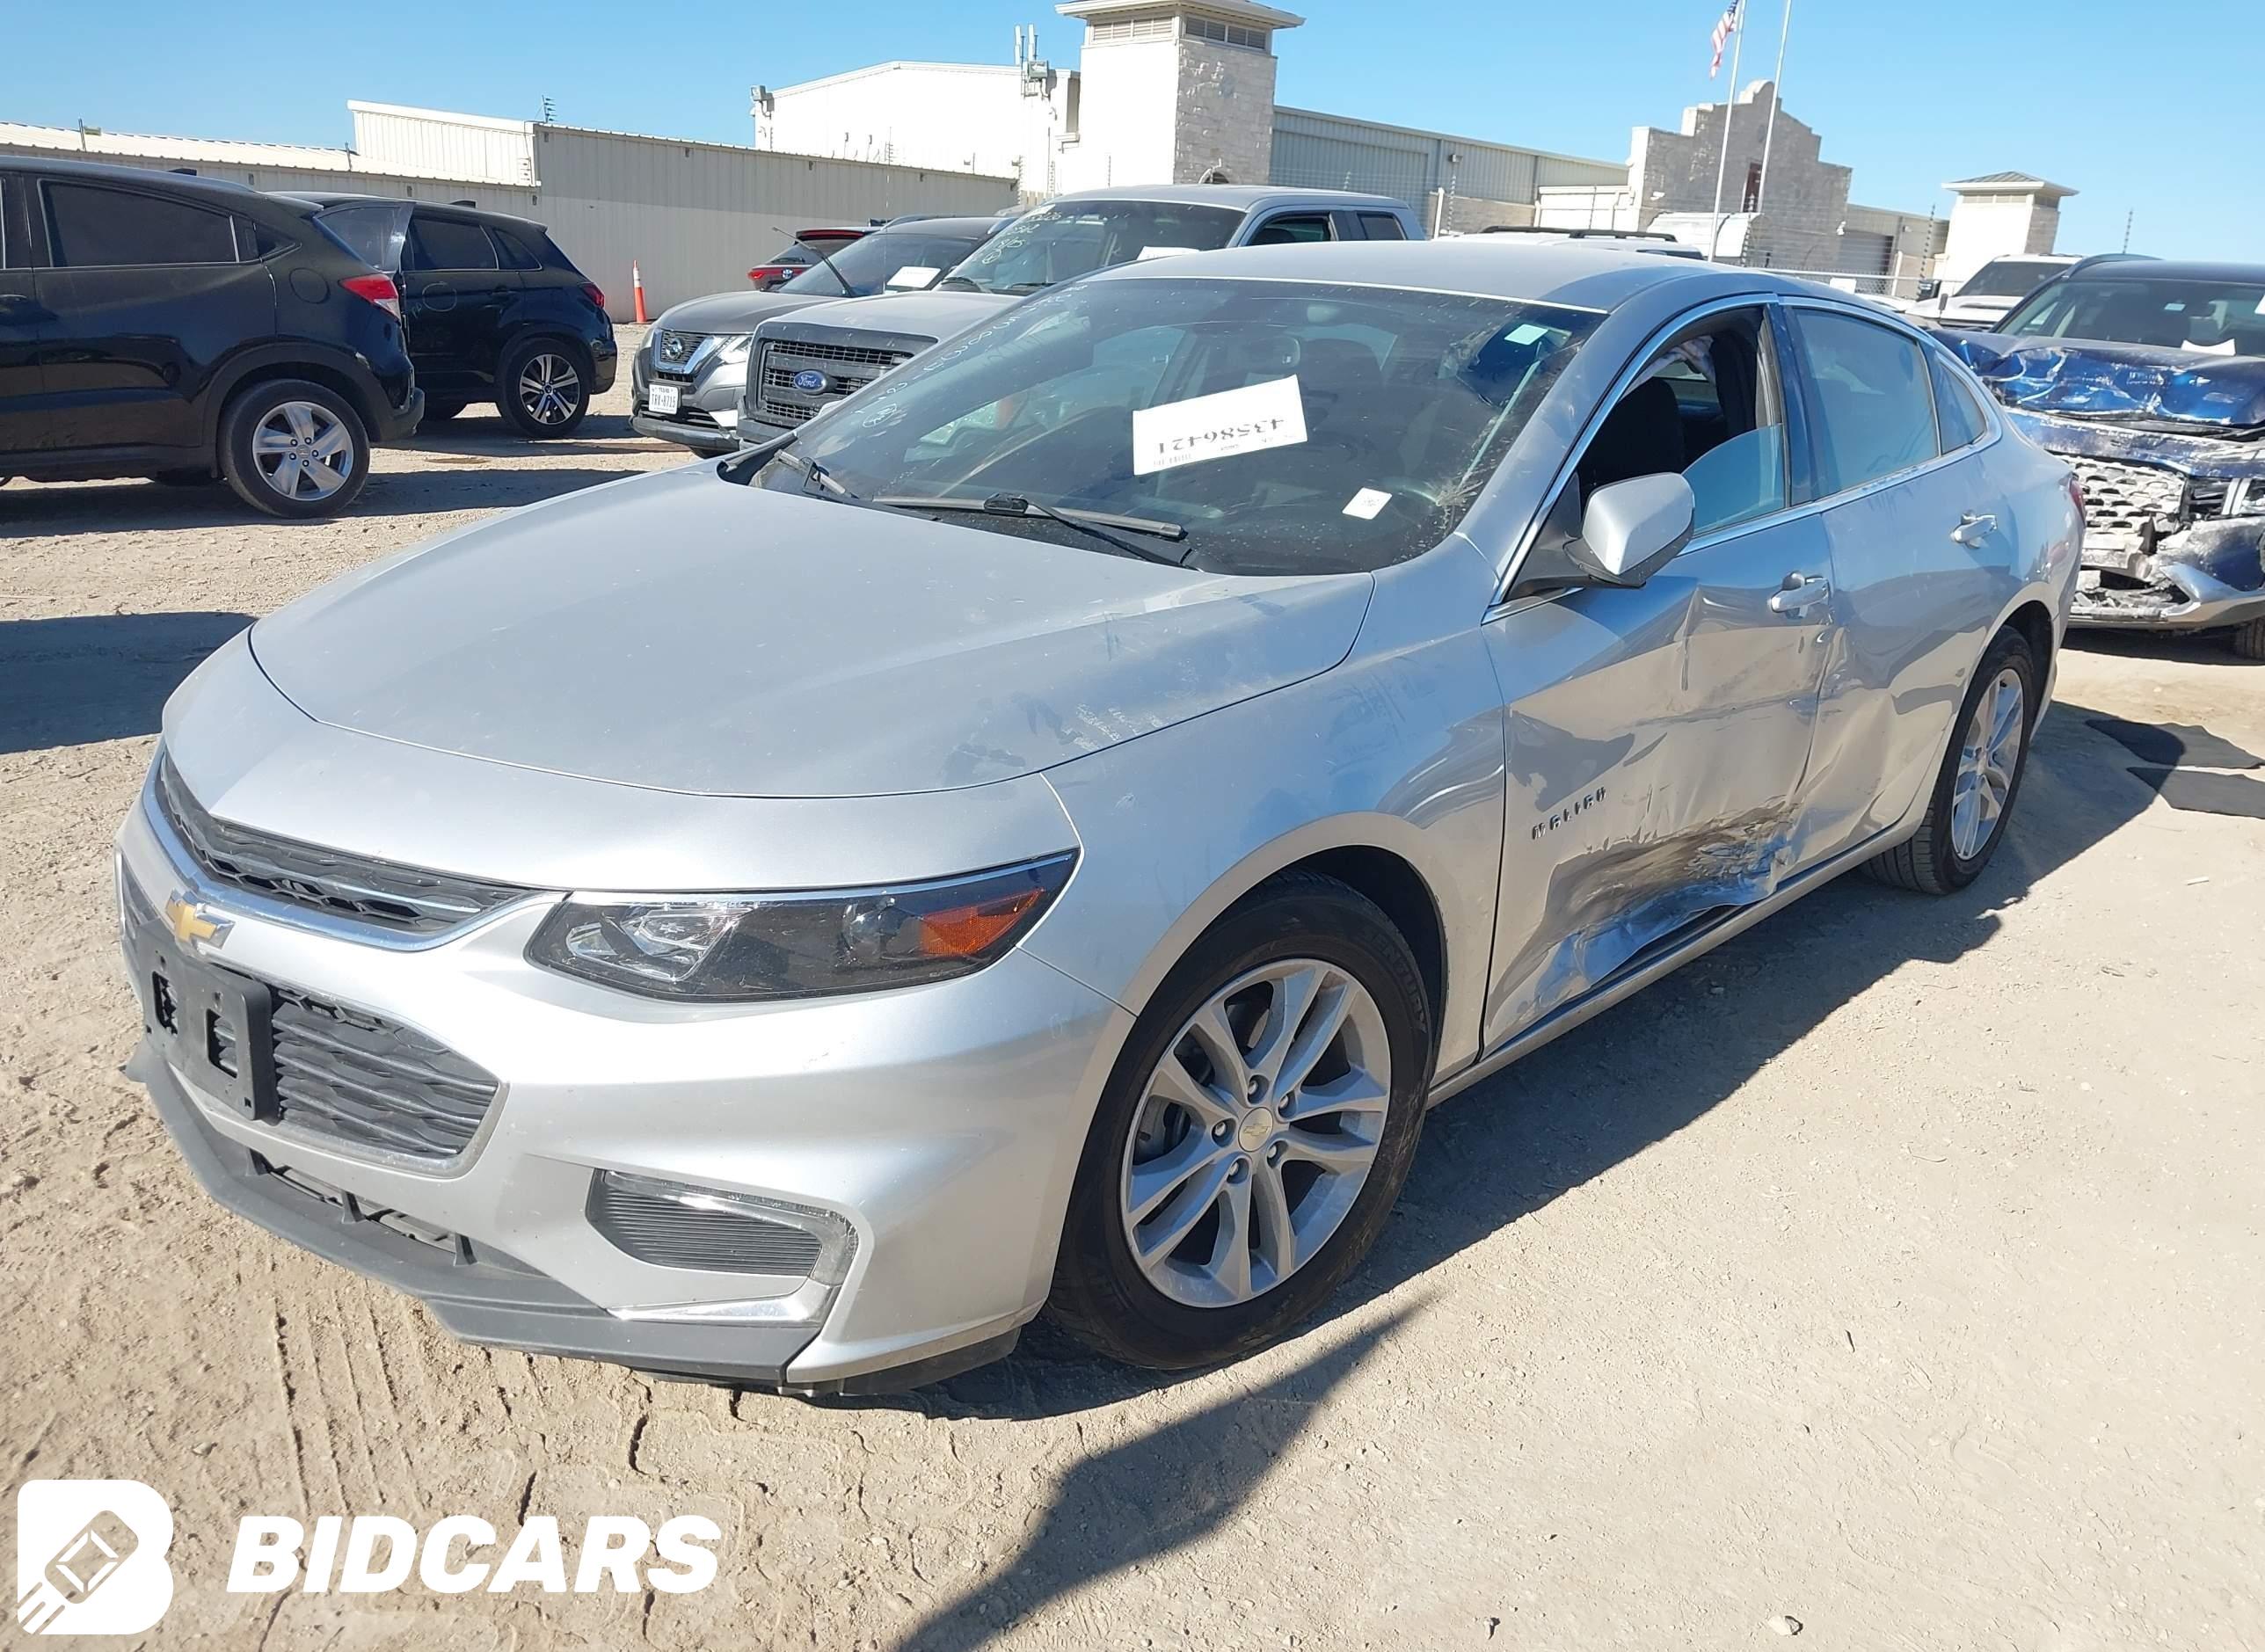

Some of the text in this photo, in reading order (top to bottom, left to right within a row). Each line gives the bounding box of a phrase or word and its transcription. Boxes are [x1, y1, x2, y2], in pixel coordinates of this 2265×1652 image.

[797, 375, 817, 387] Ford
[1159, 418, 1285, 454] 43586421
[1531, 786, 1607, 841] MALIBU
